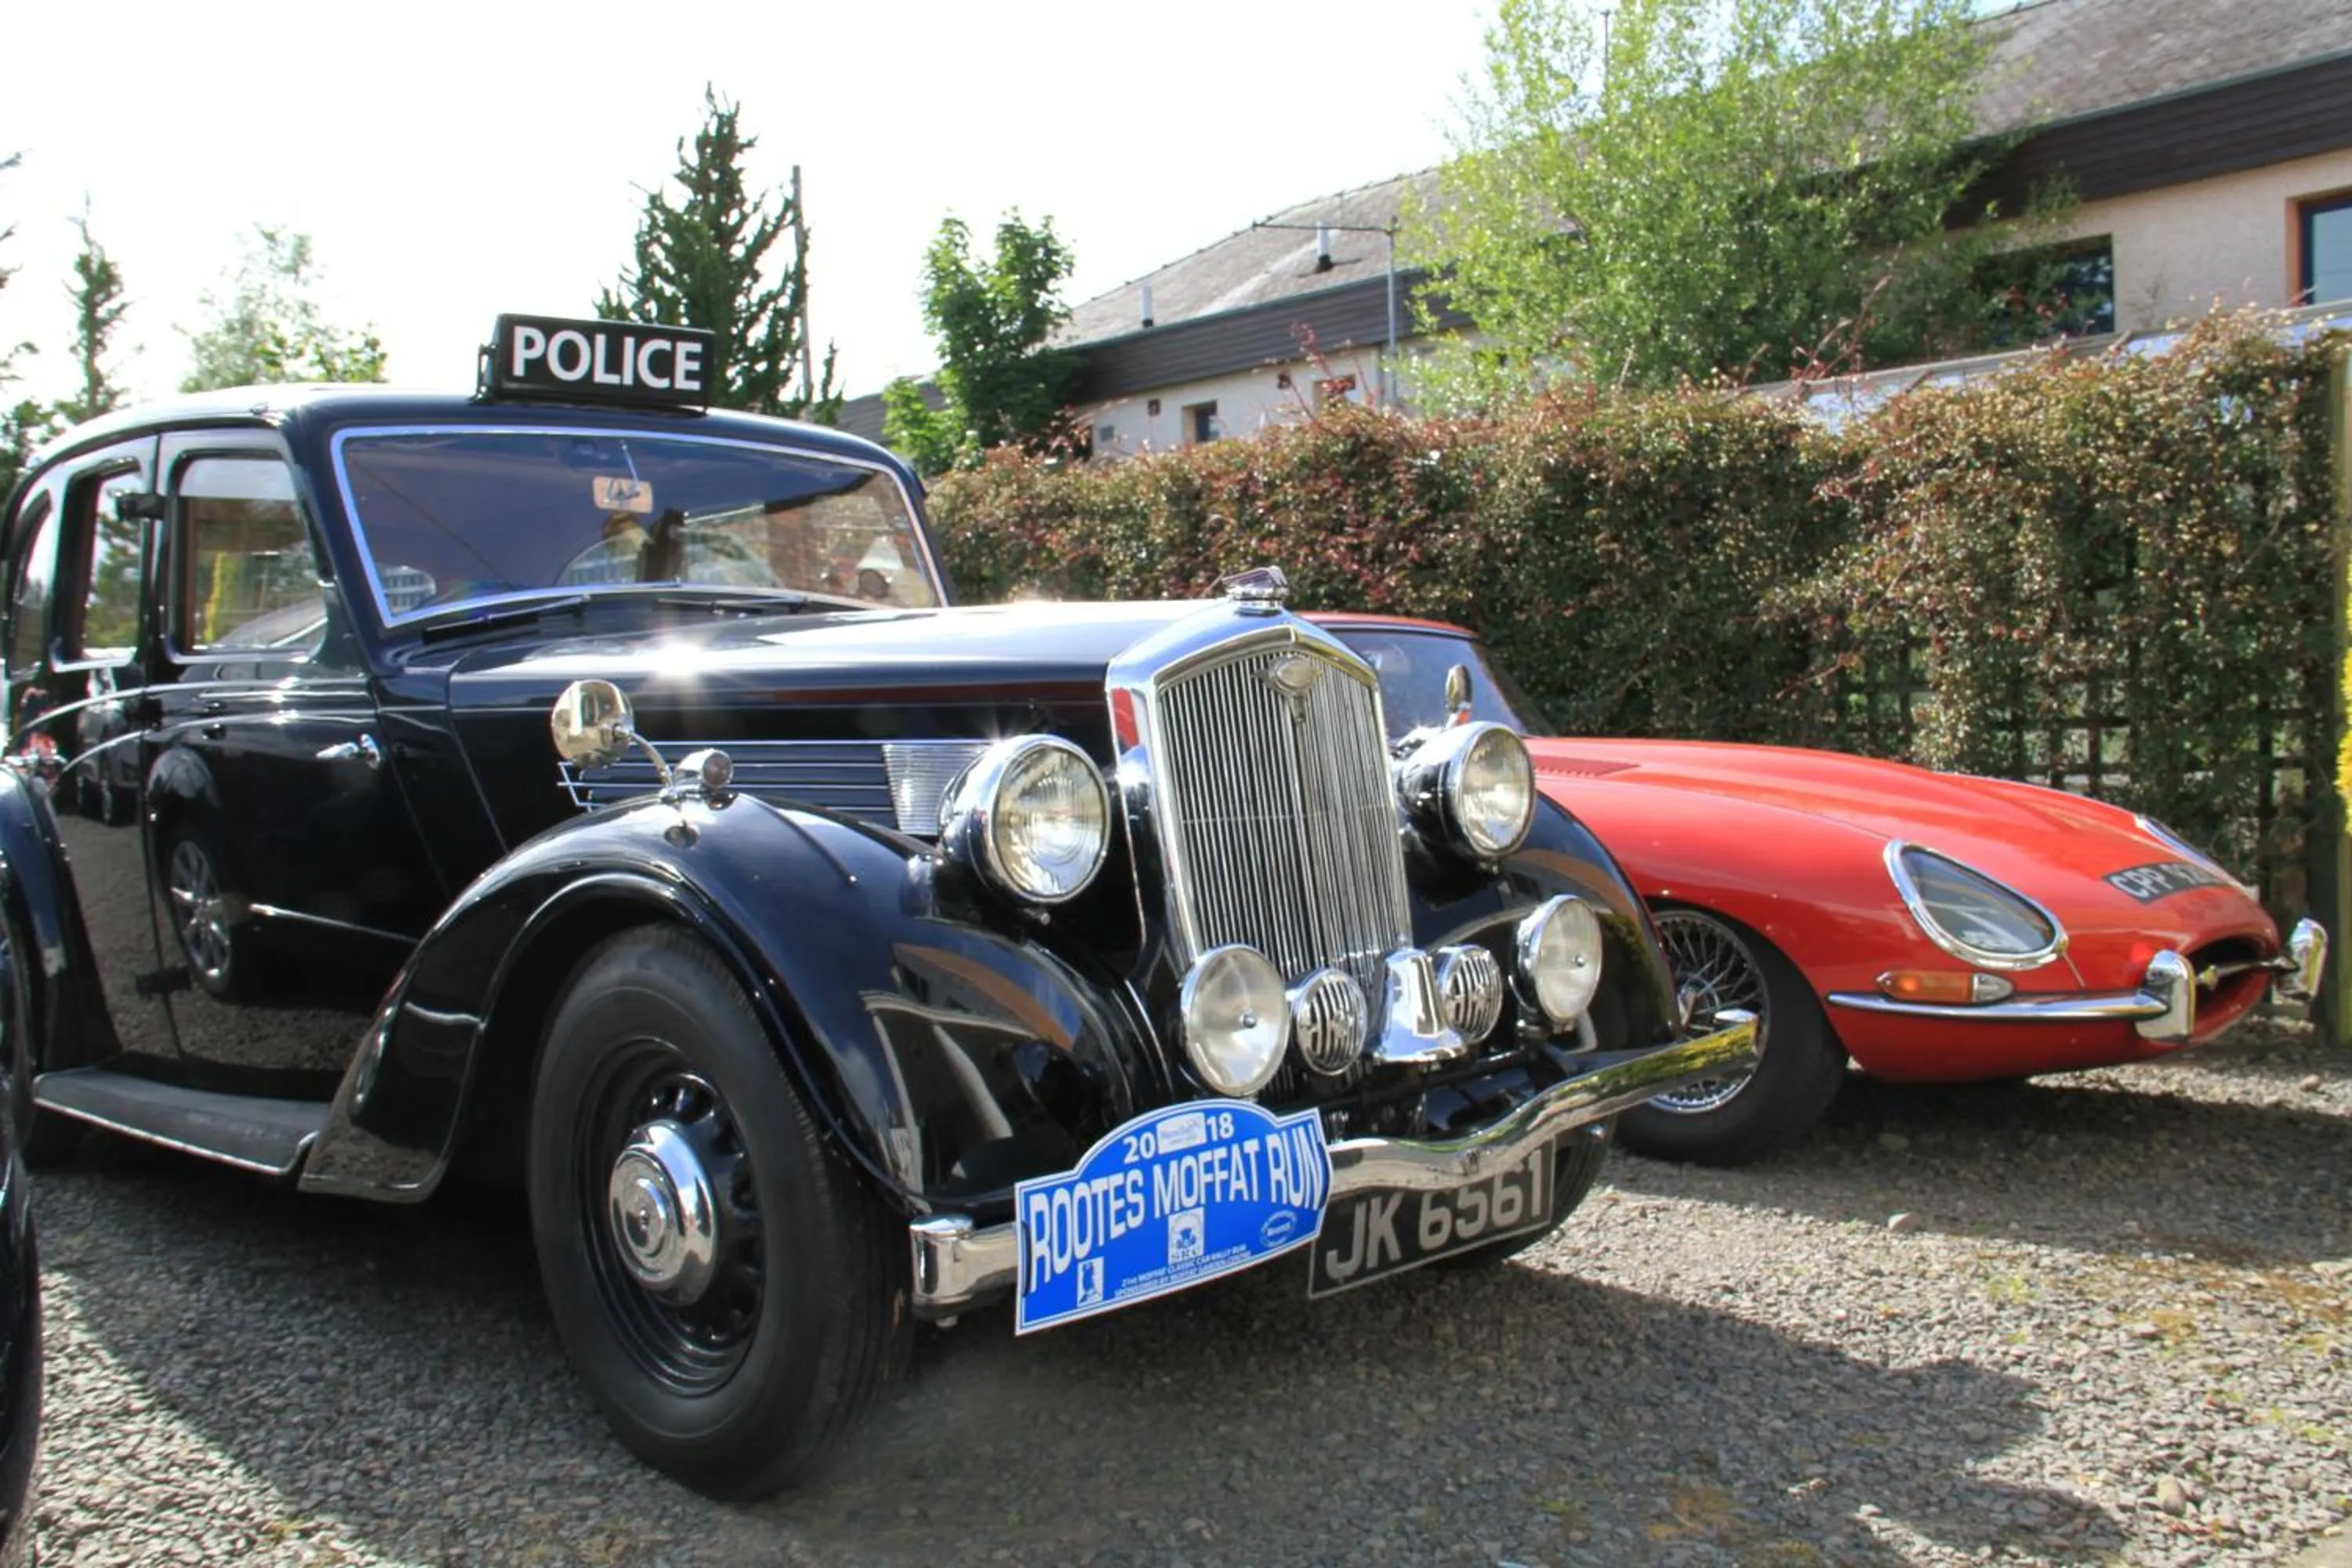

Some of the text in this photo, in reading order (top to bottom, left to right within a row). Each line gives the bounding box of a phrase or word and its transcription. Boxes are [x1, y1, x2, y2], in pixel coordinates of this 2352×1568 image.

[512, 325, 702, 391] POLICE
[1123, 1131, 1156, 1164] 20
[1206, 1112, 1235, 1142] 18
[1029, 1122, 1323, 1294] ROOTES MOFFAT RUN
[1325, 1149, 1543, 1279] JK 6561
